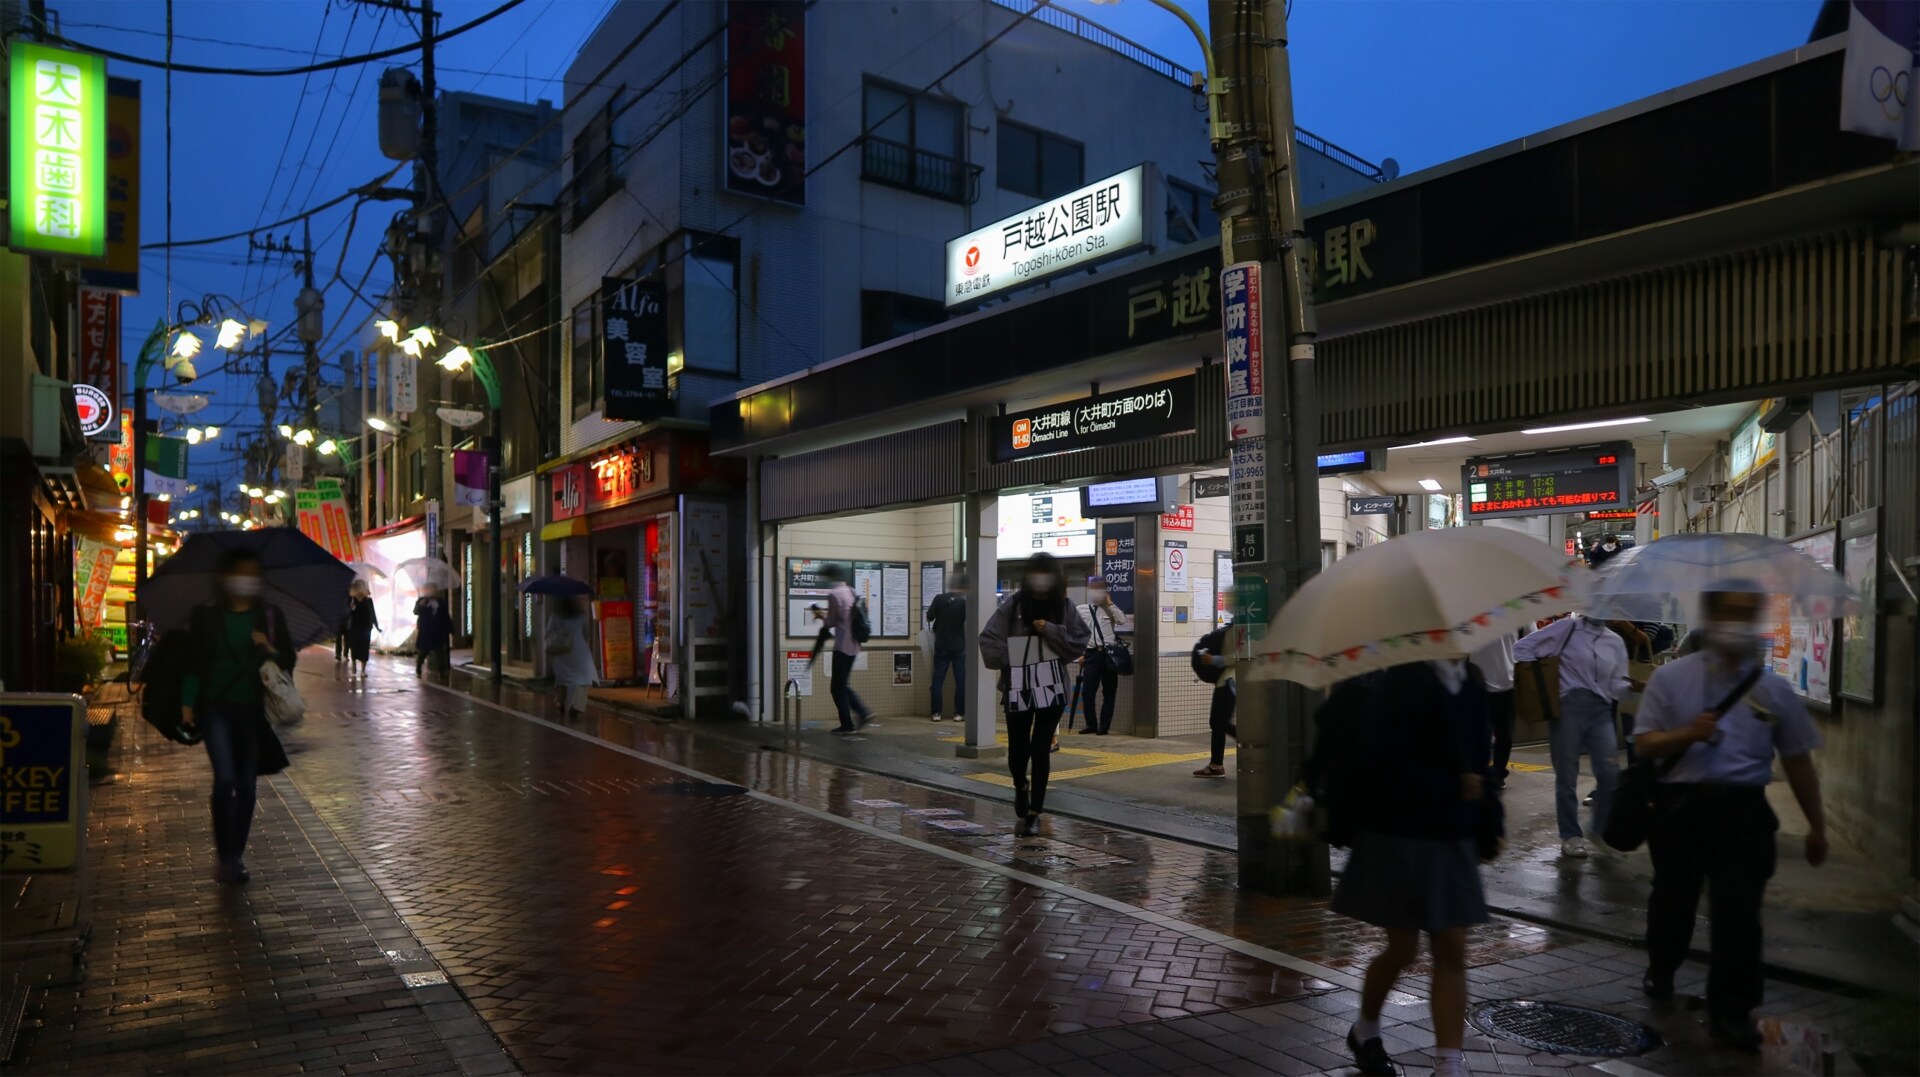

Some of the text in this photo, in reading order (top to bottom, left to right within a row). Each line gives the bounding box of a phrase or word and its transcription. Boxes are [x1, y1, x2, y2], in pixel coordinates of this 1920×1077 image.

[38, 64, 78, 237] 大木歯科
[1002, 183, 1120, 260] 戸越公園駅
[1012, 234, 1109, 277] Togoshi-kōen Sta.
[955, 274, 991, 297] 東急電鉄
[612, 283, 660, 318] Alfa
[1225, 269, 1249, 398] 学研教室
[606, 317, 664, 389] 美容室
[77, 387, 106, 408] BURGER
[1016, 424, 1027, 433] OM
[1032, 410, 1071, 431] 大井町線
[1080, 419, 1116, 434] for Ōimachi
[1031, 428, 1069, 443] Ōimachi Line
[1470, 465, 1478, 478] 2
[1533, 476, 1554, 488] 17:43
[561, 472, 579, 516] Alfa
[1493, 479, 1526, 491] 大井町
[1493, 490, 1526, 502] 大井町
[1163, 517, 1193, 528] 持込み厳禁
[1105, 572, 1128, 584] のりば
[0, 791, 60, 813] FEE
